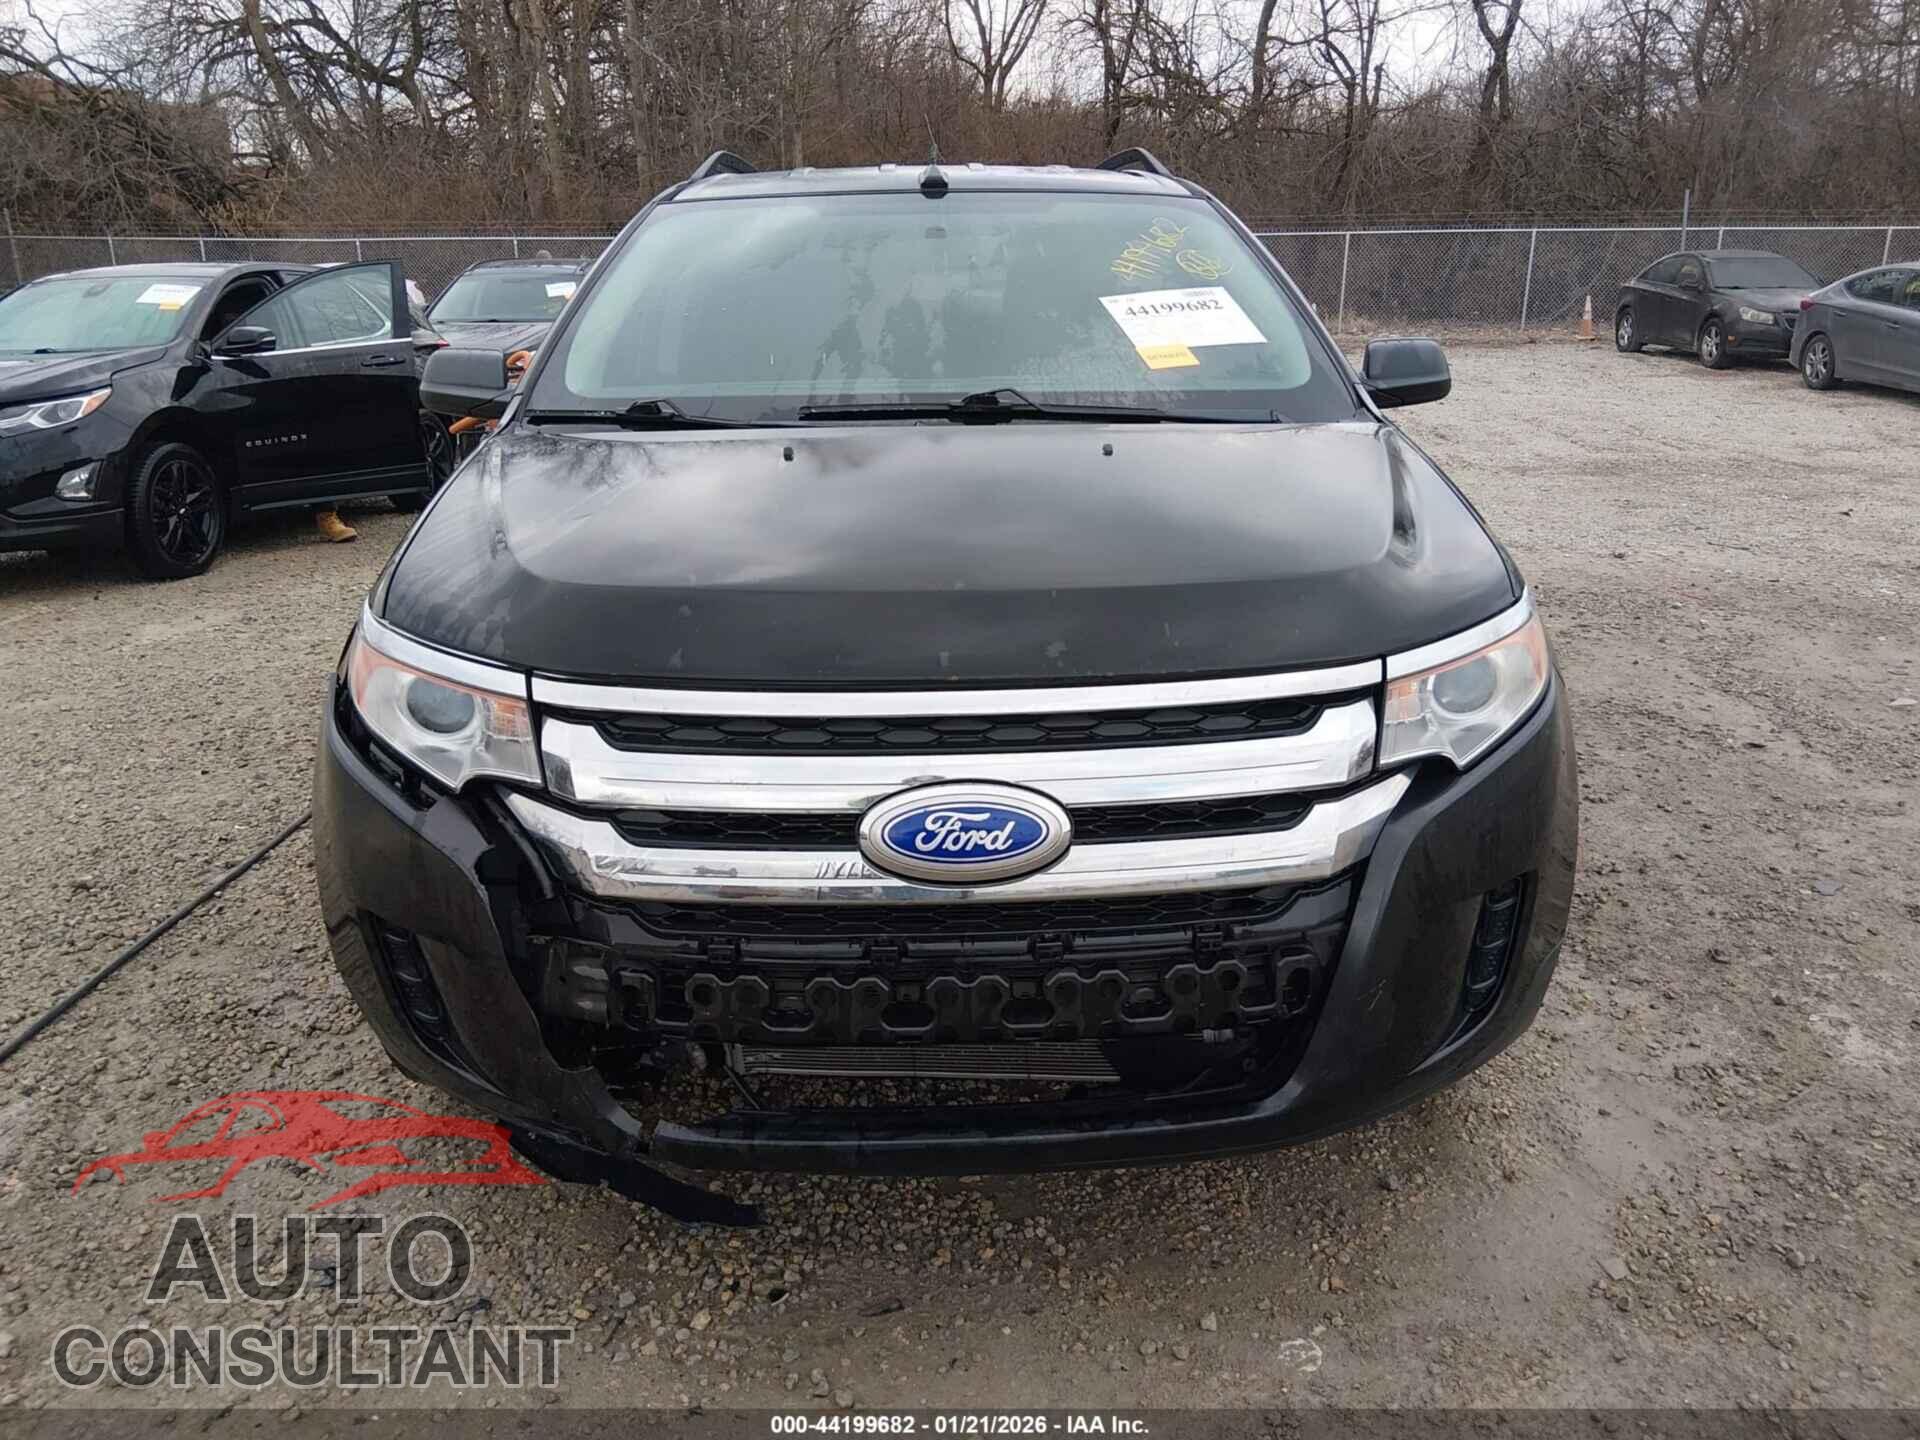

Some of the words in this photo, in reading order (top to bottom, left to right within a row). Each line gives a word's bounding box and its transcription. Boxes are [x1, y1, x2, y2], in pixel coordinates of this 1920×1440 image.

[1125, 299, 1224, 317] 44199682
[246, 433, 307, 448] EQUINOX
[915, 811, 1015, 852] Ford
